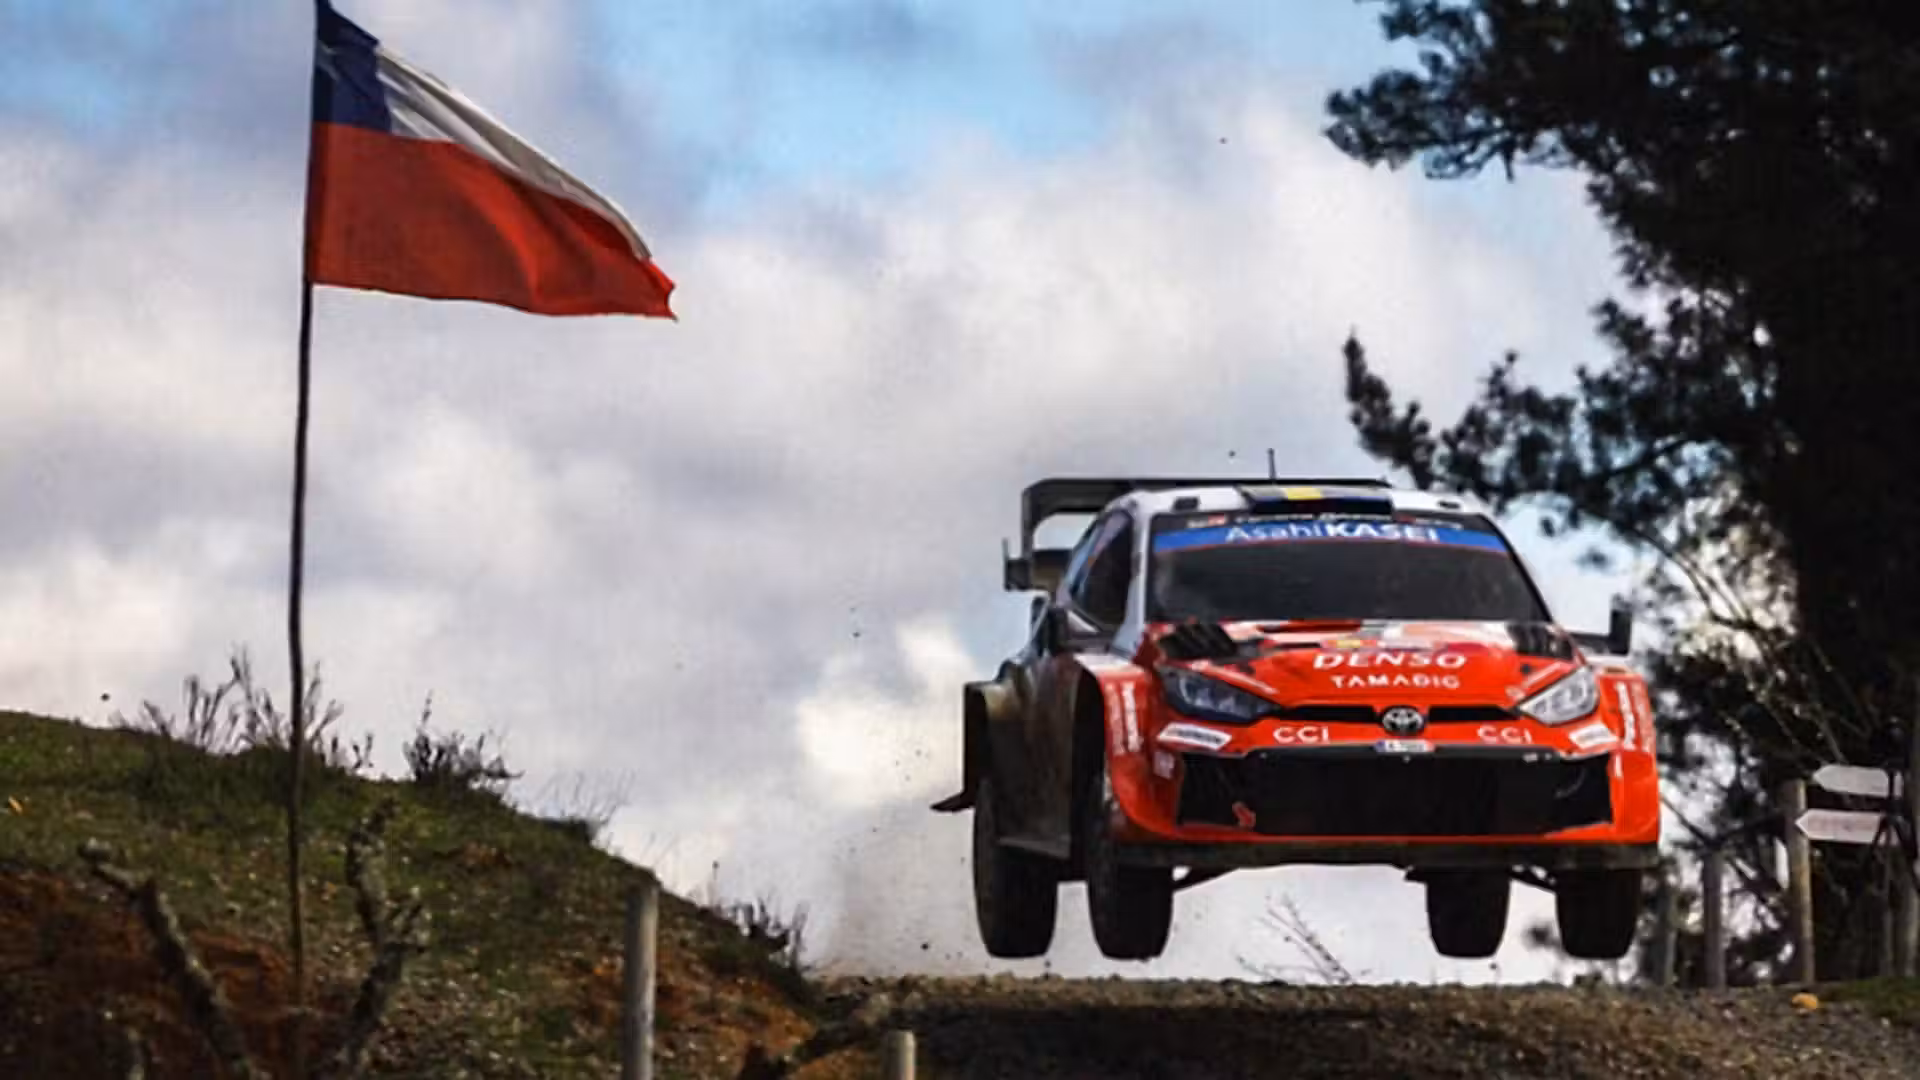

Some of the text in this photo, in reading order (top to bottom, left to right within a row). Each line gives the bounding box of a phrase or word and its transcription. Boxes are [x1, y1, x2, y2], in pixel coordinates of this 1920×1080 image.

[1313, 652, 1466, 669] DENSO
[1273, 726, 1329, 744] CCI
[1477, 725, 1532, 744] CCI
